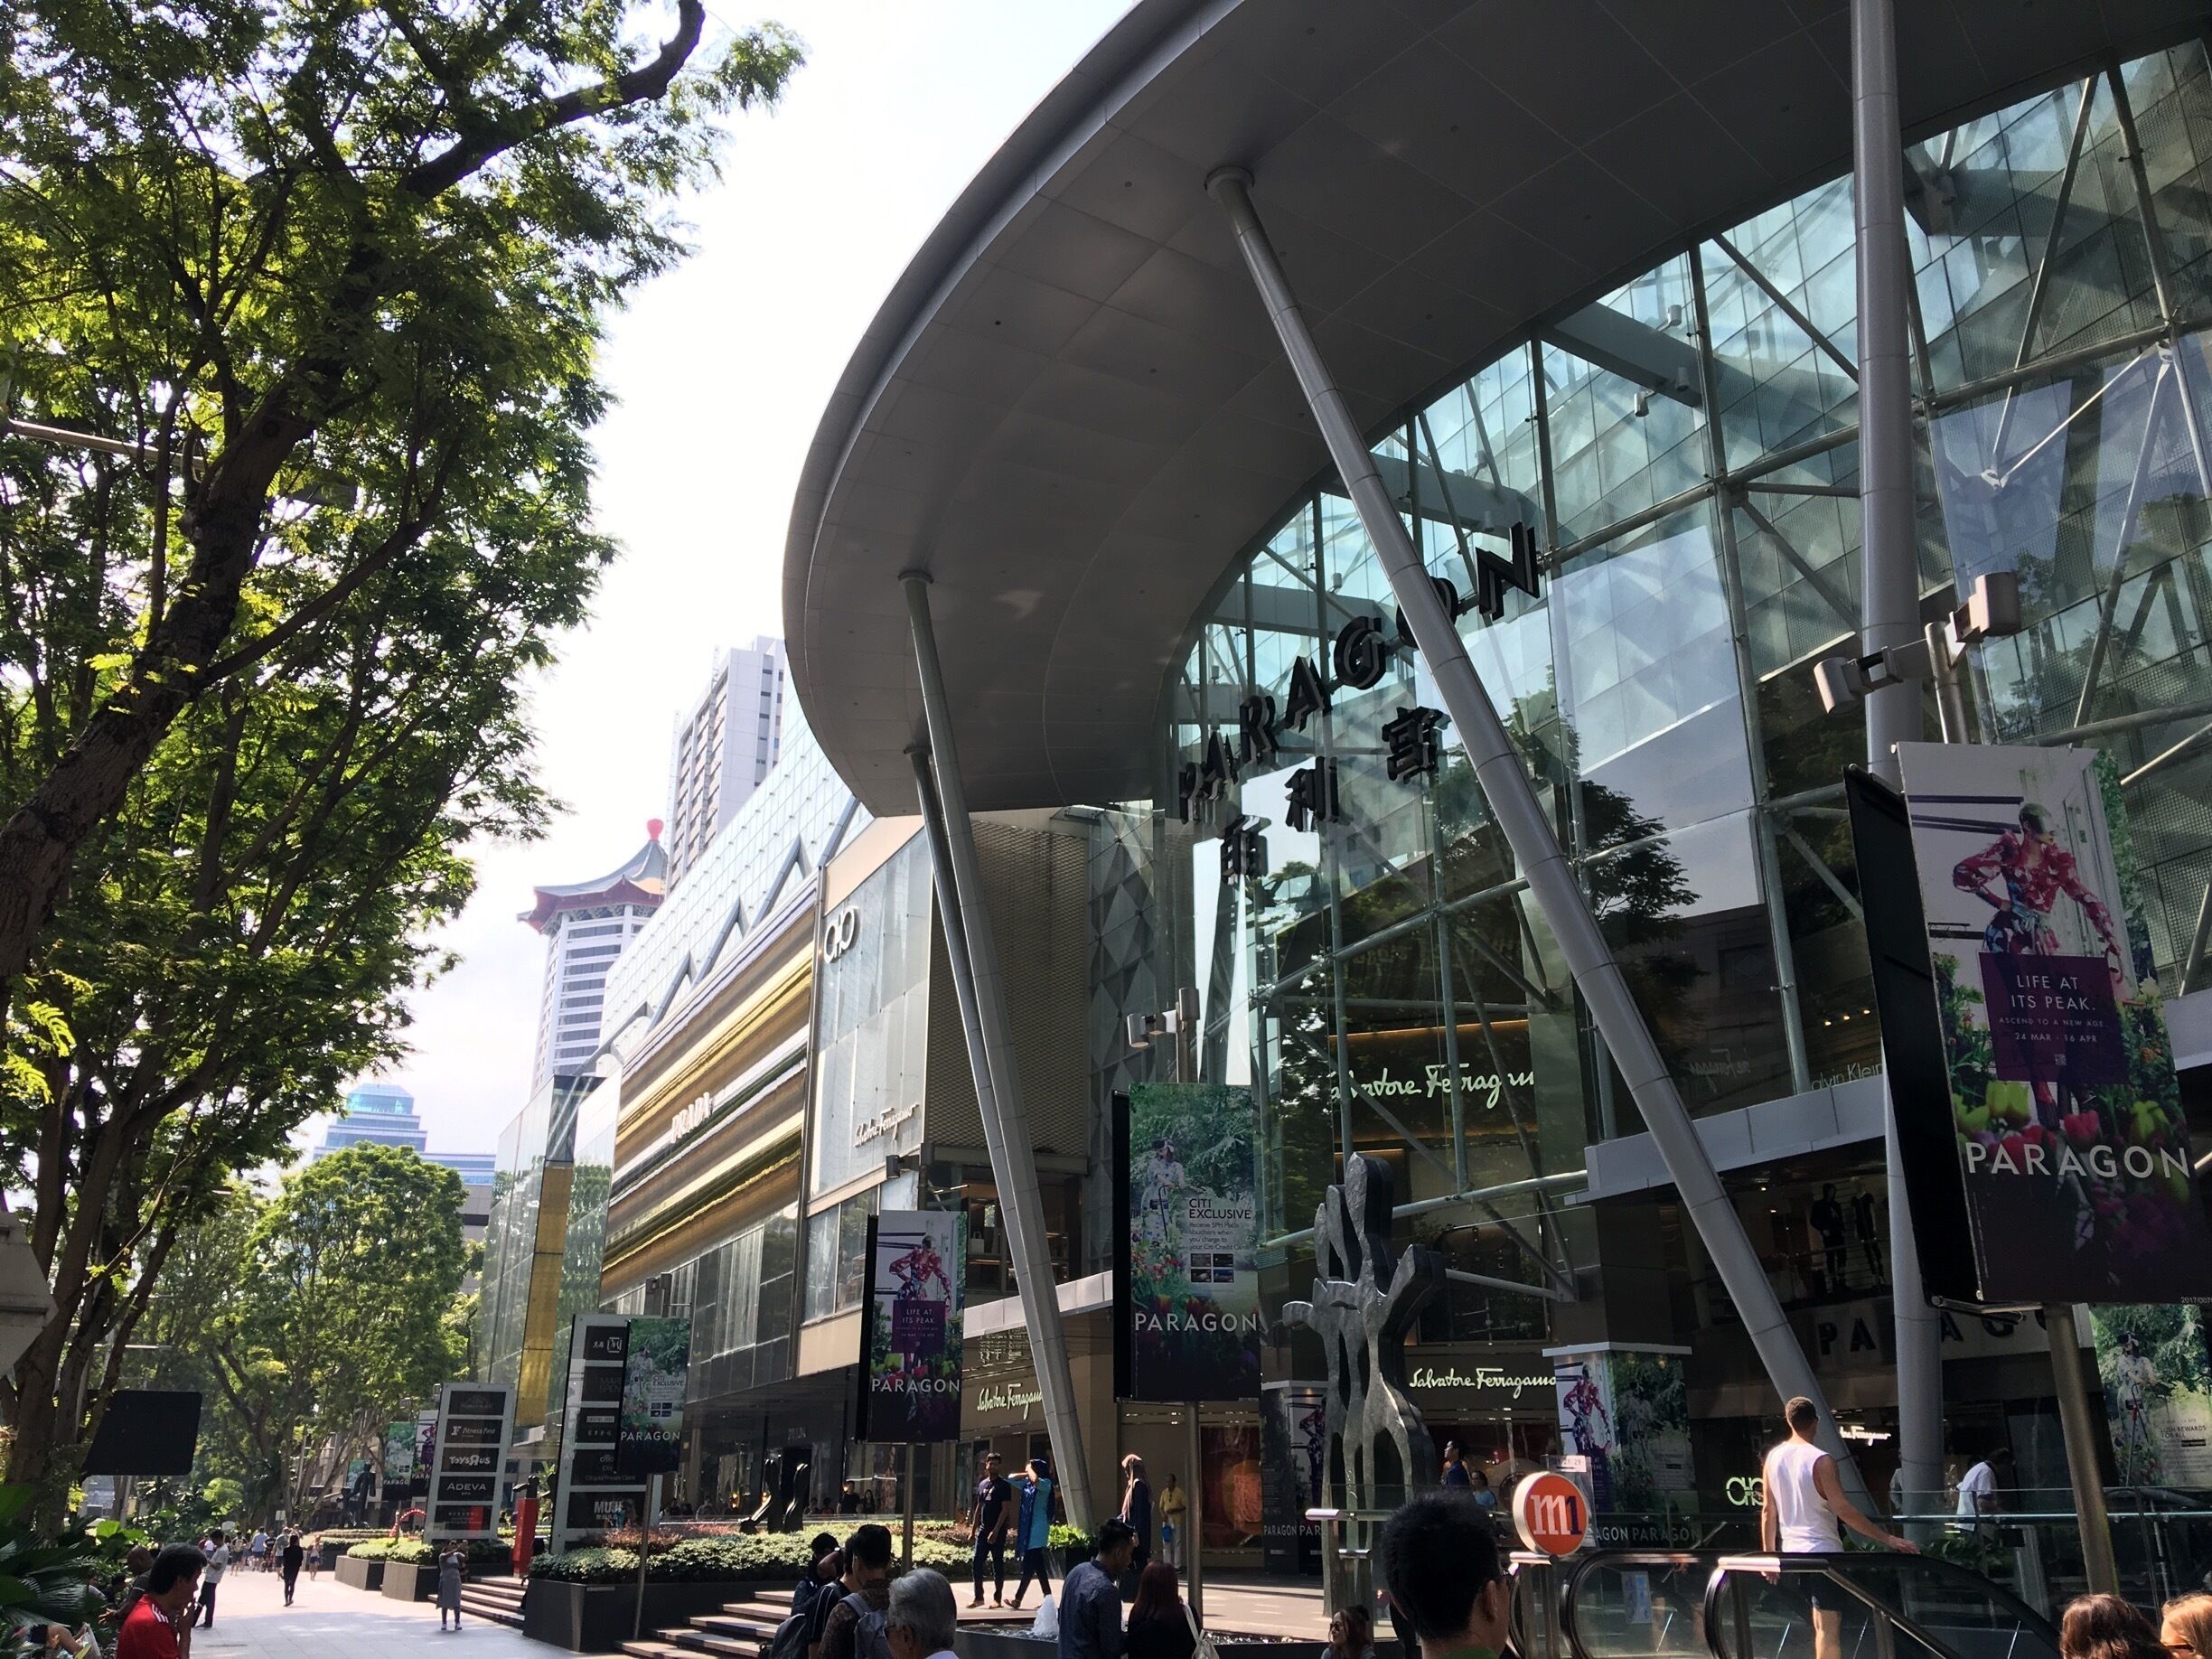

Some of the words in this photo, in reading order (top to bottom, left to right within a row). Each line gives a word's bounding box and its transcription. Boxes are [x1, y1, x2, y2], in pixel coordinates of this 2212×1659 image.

[2016, 975, 2050, 989] LIFE
[2059, 977, 2078, 990] AT
[2010, 995, 2037, 1008] ITS
[2045, 996, 2096, 1011] PEAK.
[1999, 1017, 2033, 1026] ASCEND
[2053, 1018, 2059, 1026] A
[2015, 1032, 2026, 1040] 24
[2030, 1033, 2052, 1042] MAR
[2064, 1034, 2076, 1043] 16
[2079, 1035, 2097, 1043] APR
[1811, 1069, 1845, 1092] alvin
[1847, 1059, 1883, 1082] Klein
[670, 1092, 710, 1143] PRADA
[1965, 1141, 2190, 1179] PARAGON
[1189, 1198, 1212, 1209] CITI
[1189, 1209, 1251, 1220] EXCLUSIVE
[1135, 1312, 1257, 1332] PARAGON
[871, 1379, 961, 1392] PARAGON
[1410, 1367, 1475, 1389] Salvatore
[1476, 1367, 1556, 1399] Ferragamo
[1007, 1383, 1043, 1420] Ferragam
[620, 1431, 680, 1441] PARAGON
[447, 1482, 486, 1491] ADEVA
[1264, 1524, 1298, 1536] PARAGON
[1633, 1526, 1701, 1541] PARAGON
